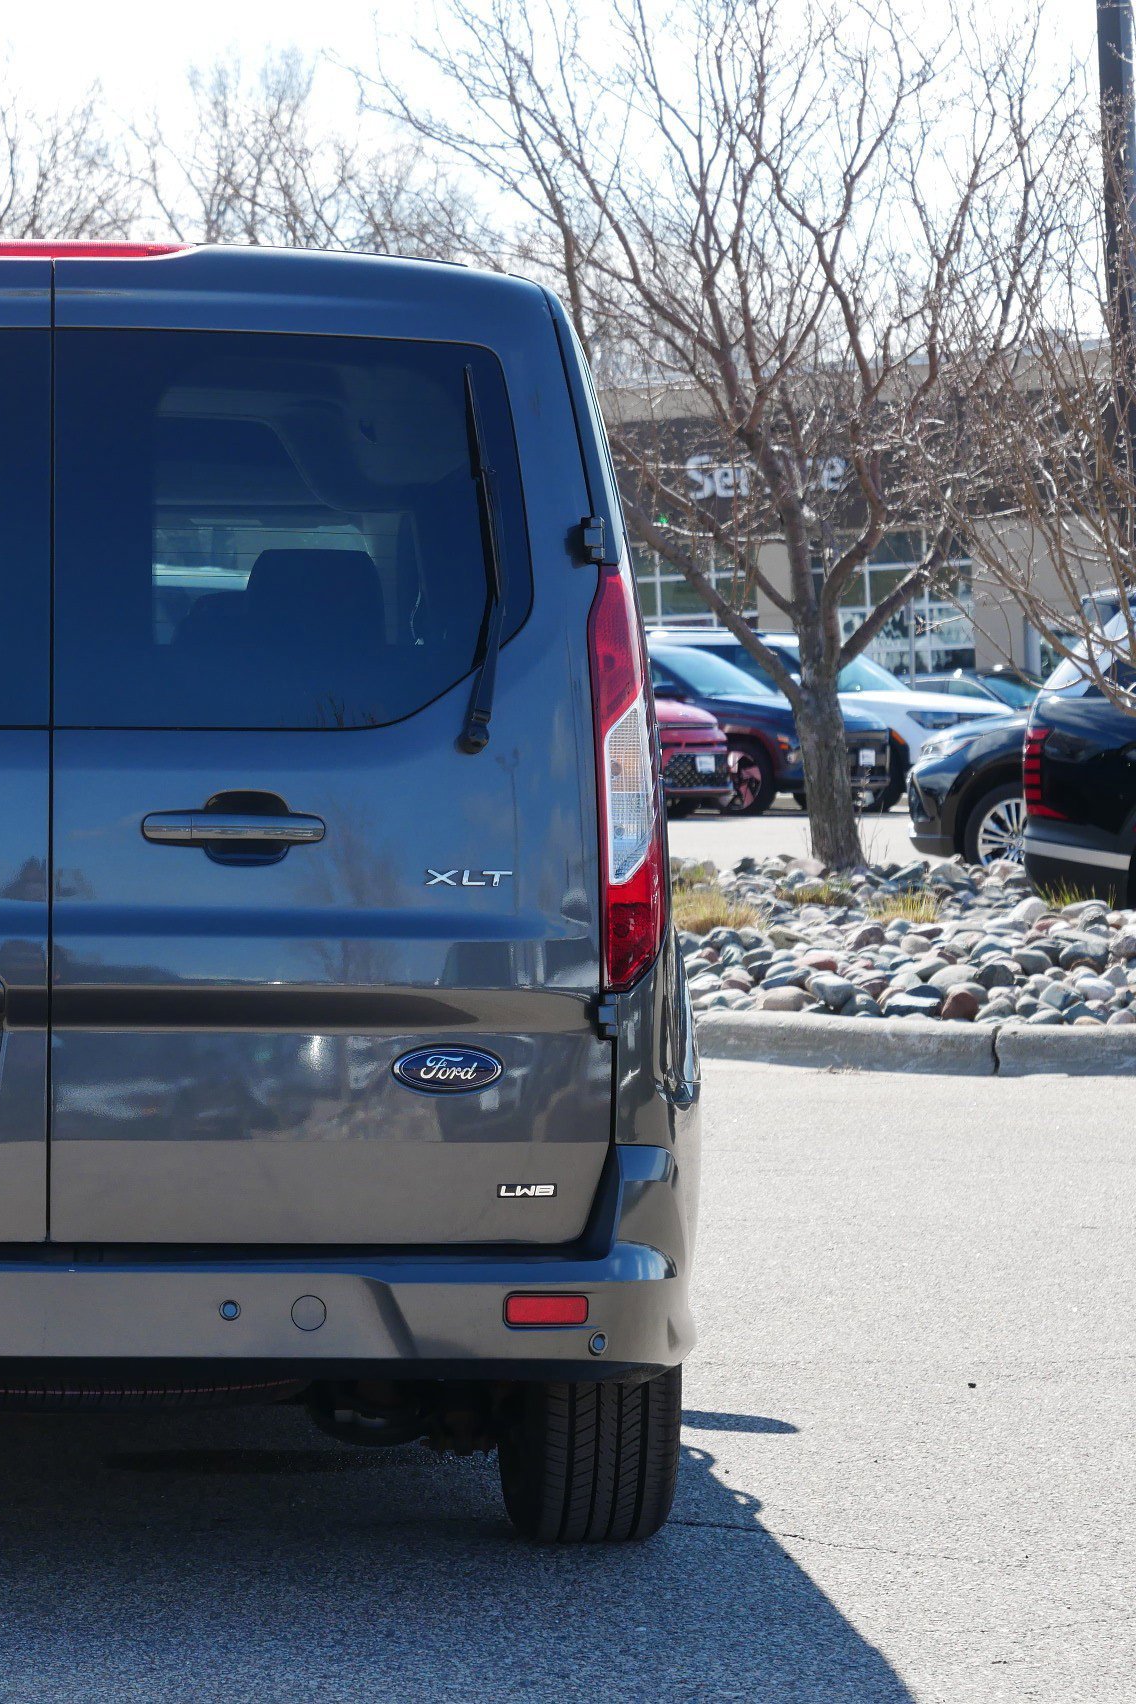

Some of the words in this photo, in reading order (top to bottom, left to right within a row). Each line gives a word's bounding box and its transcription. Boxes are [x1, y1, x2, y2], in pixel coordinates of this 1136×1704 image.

[426, 869, 513, 887] XLT
[420, 1055, 478, 1080] Ford
[500, 1184, 555, 1197] LWB
